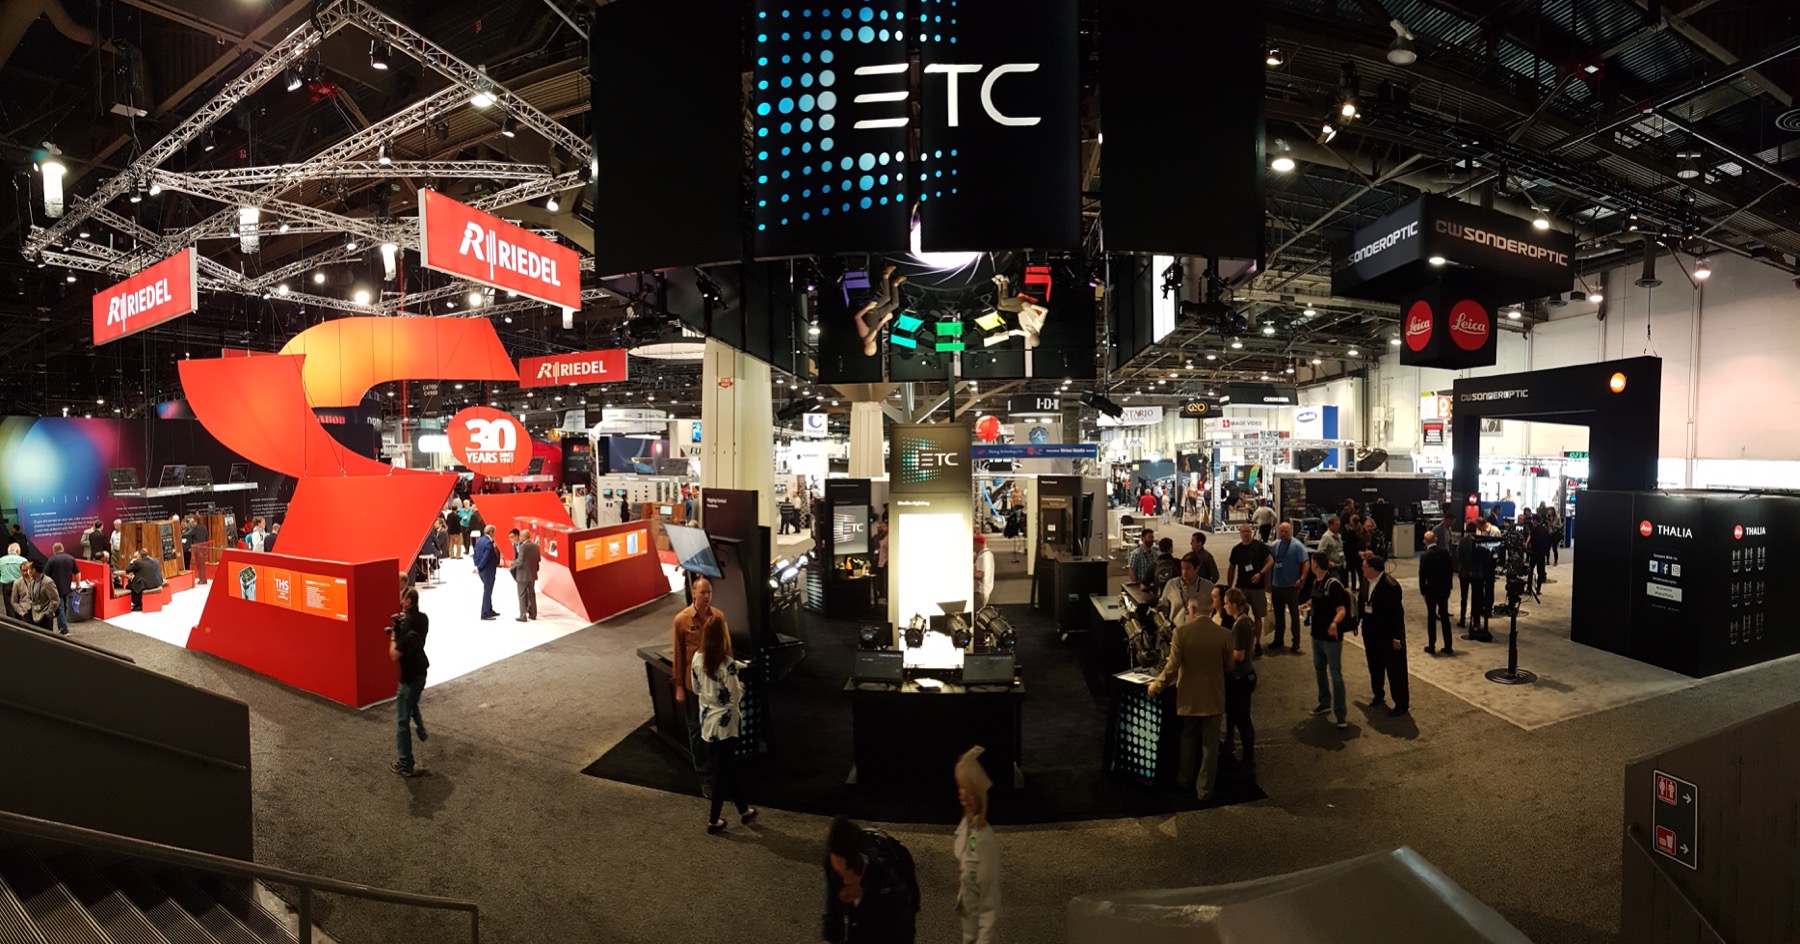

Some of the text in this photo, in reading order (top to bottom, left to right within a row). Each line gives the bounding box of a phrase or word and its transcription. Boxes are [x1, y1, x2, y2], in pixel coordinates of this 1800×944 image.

[853, 62, 1041, 130] ETC
[499, 239, 561, 287] RIEDEL
[127, 278, 172, 318] RIEDEL
[1406, 316, 1431, 336] Leica
[1451, 312, 1487, 335] Leica
[560, 360, 607, 377] RIEDEL
[465, 418, 517, 451] 30
[465, 452, 498, 464] YEARS
[921, 452, 959, 467] ETC
[843, 523, 864, 533] ETC
[1657, 524, 1693, 539] THALIA
[1745, 526, 1766, 536] THALIA
